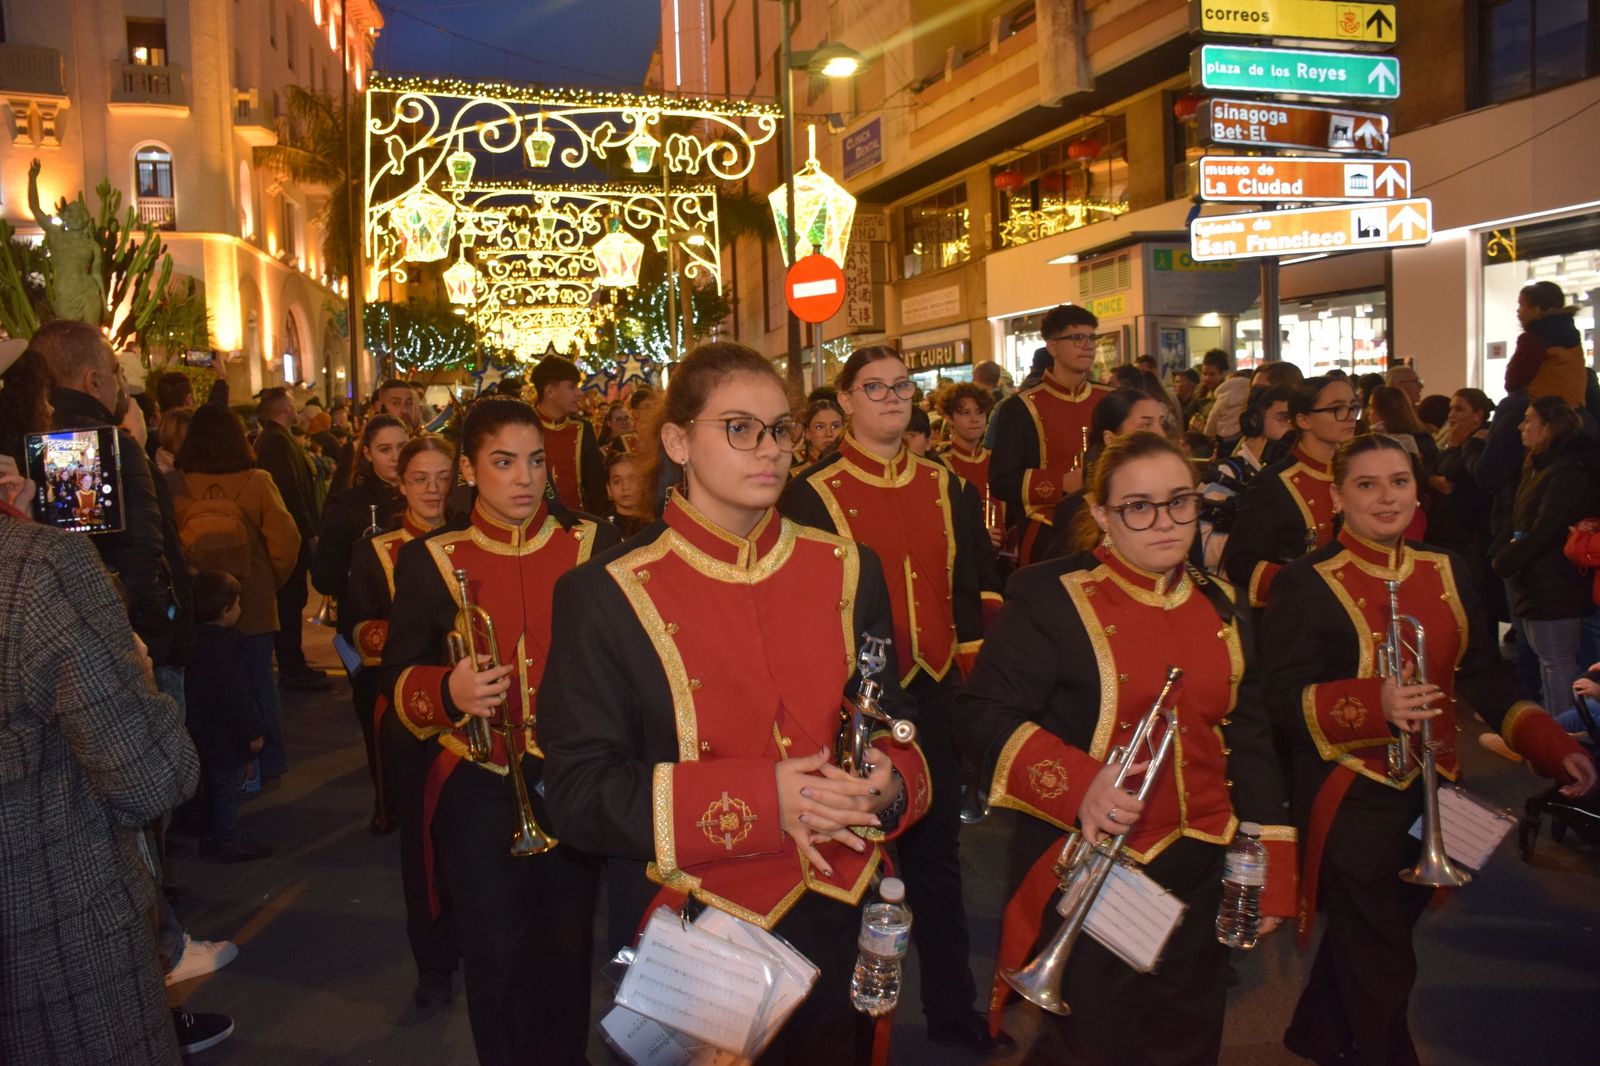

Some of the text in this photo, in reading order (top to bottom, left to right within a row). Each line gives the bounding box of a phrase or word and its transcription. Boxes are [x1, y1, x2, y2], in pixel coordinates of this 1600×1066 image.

[1205, 8, 1270, 23] correos
[1206, 61, 1347, 83] plaza de los Reyes
[1214, 103, 1288, 126] sinagoga
[1213, 122, 1267, 142] Bet-El
[1205, 163, 1275, 176] museo de
[1205, 178, 1303, 195] La Ciudad
[1197, 231, 1347, 255] San Francisco
[1096, 296, 1123, 316] ONCE
[920, 346, 953, 367] GURU
